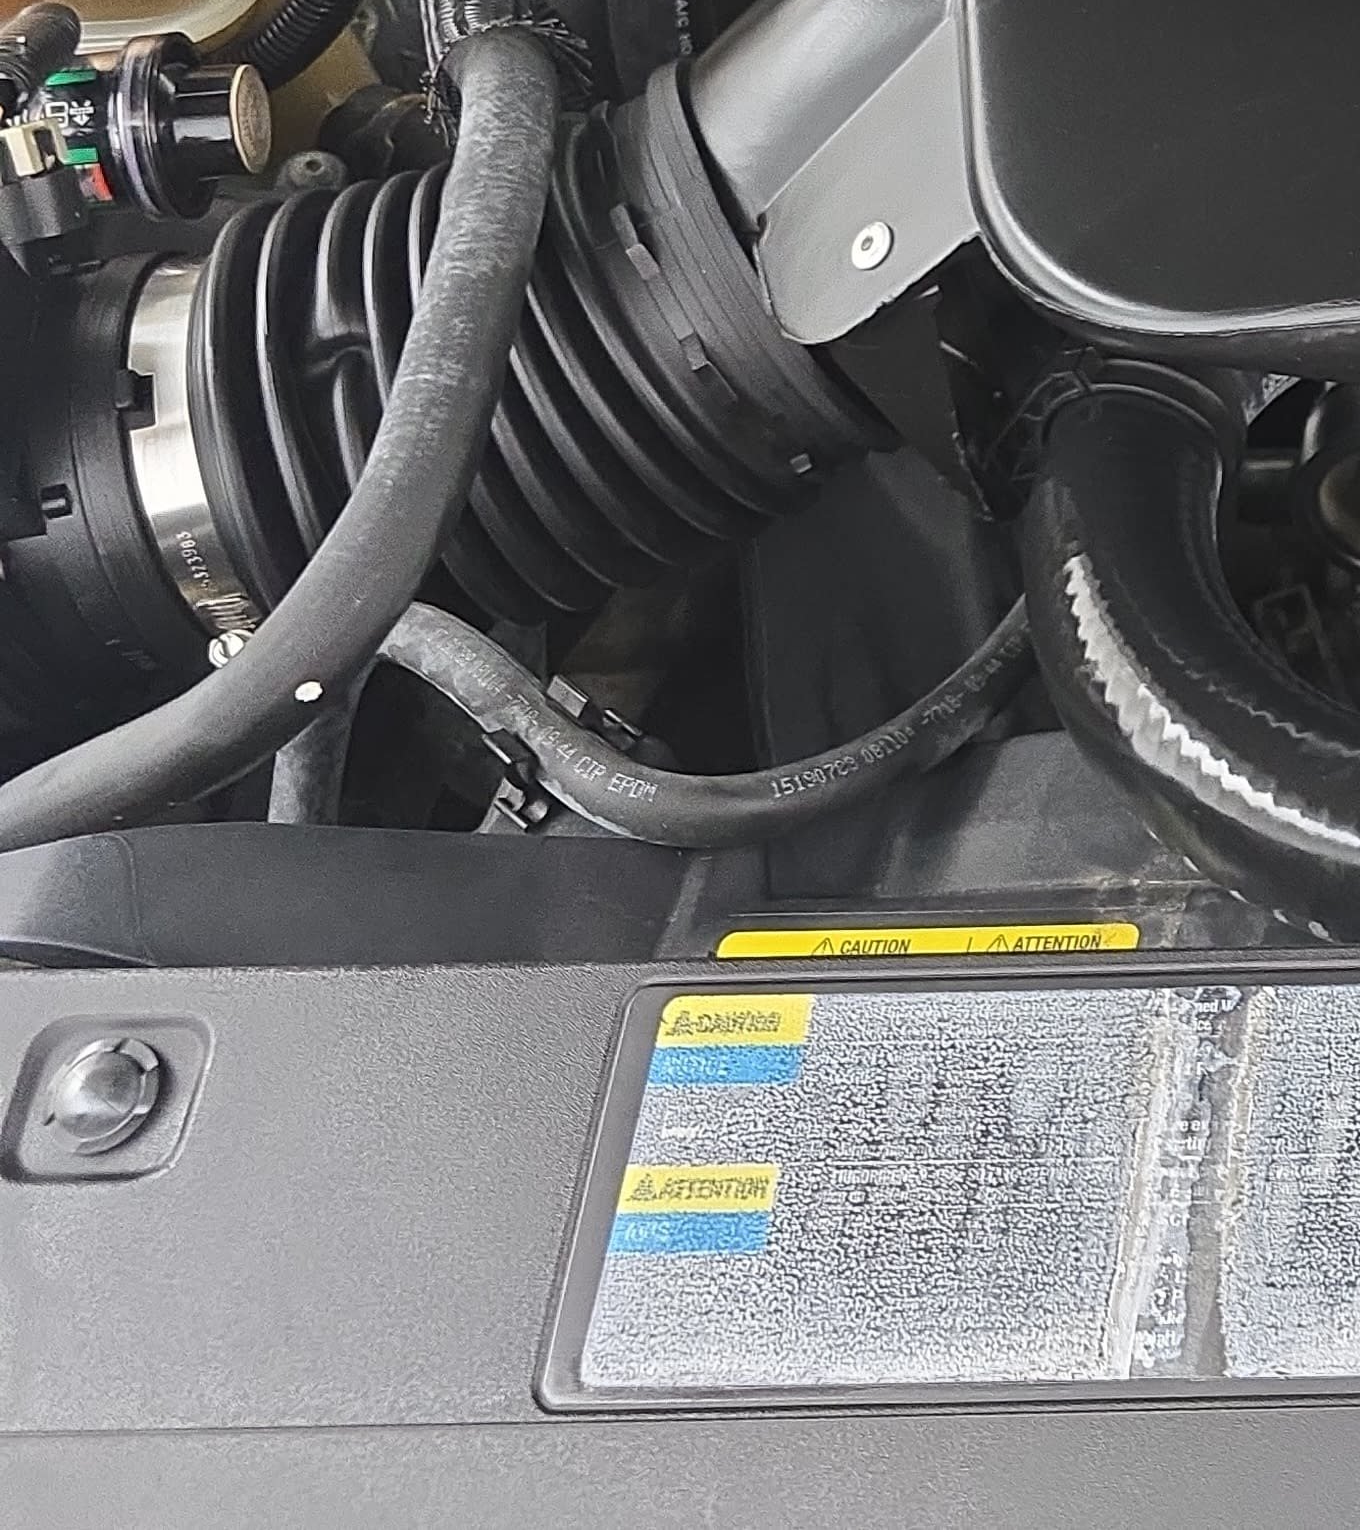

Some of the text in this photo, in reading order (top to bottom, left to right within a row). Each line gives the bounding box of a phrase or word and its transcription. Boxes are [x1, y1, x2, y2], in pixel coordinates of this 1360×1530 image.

[607, 772, 659, 802] EPDM
[840, 933, 1101, 955] CAUTION ATTENTION
